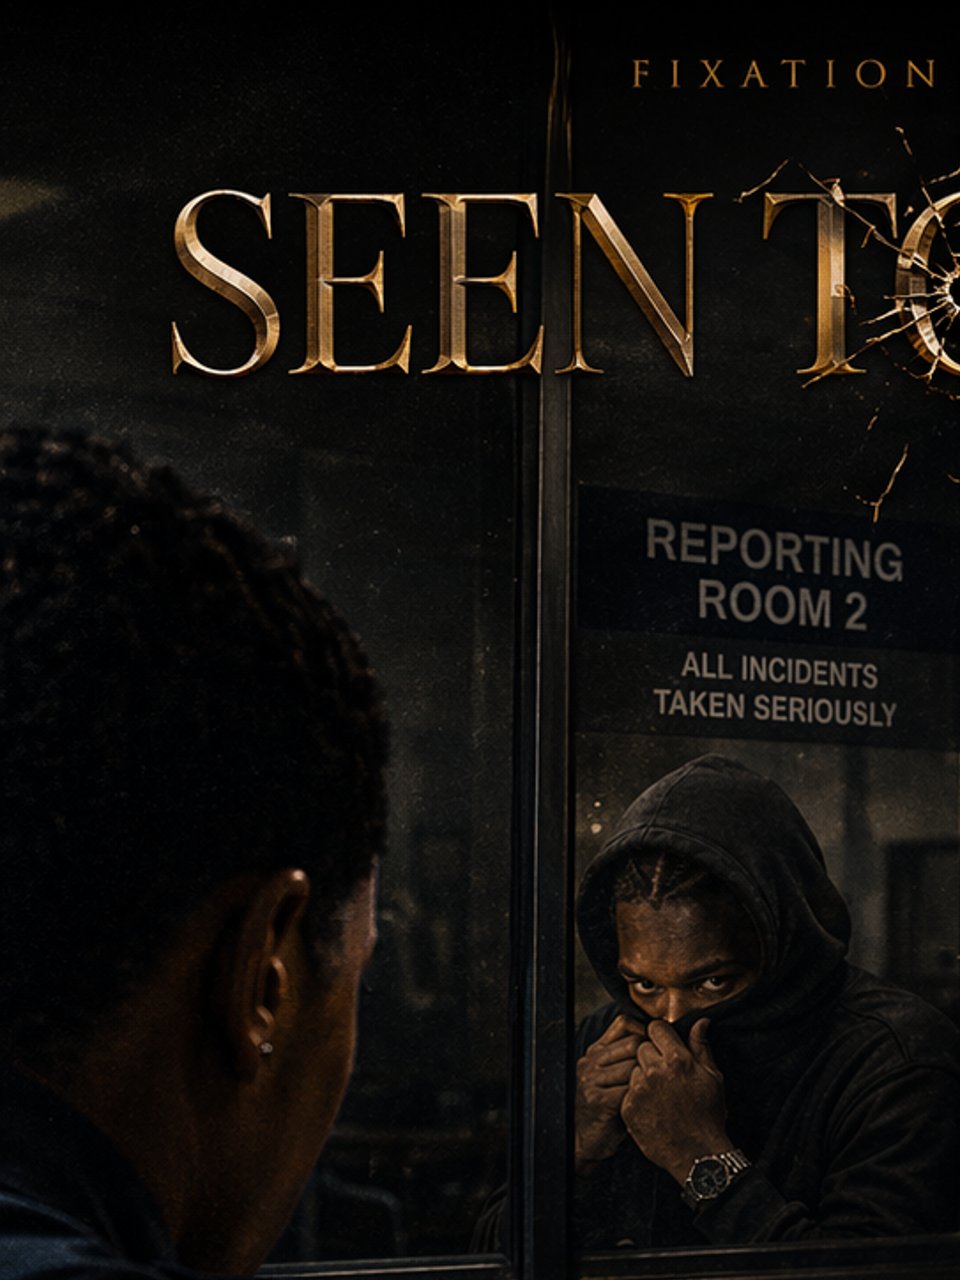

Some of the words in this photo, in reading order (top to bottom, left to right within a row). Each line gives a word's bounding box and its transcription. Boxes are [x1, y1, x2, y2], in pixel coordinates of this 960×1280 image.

[645, 516, 904, 583] REPORTING
[697, 577, 832, 629] ROOM
[843, 591, 868, 632] 2
[680, 651, 733, 681] ALL
[740, 654, 879, 690] INCIDENTS
[653, 688, 745, 720] TAKEN
[753, 694, 898, 728] SERIOUSLY
